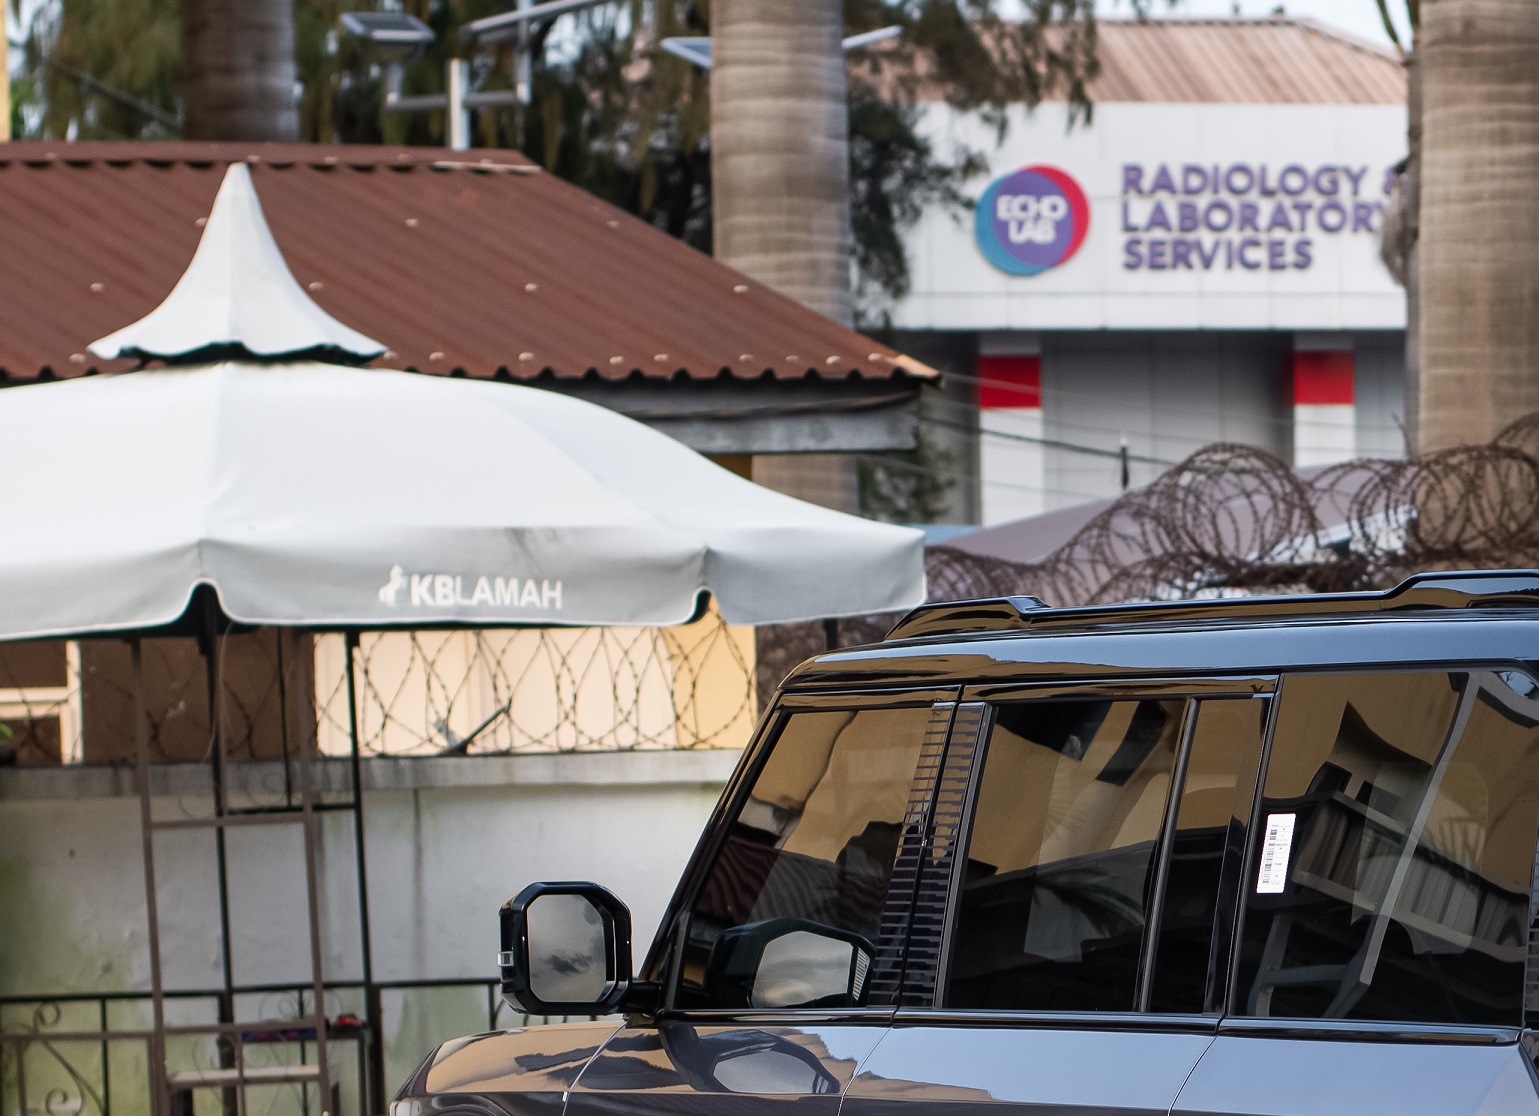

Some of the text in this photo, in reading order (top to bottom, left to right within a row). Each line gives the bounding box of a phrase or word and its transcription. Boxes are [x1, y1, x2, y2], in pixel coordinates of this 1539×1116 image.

[1122, 163, 1369, 196] RADIOLOGY
[996, 194, 1068, 220] ECHO
[1008, 219, 1057, 244] LAB
[1123, 237, 1314, 270] SERVICES
